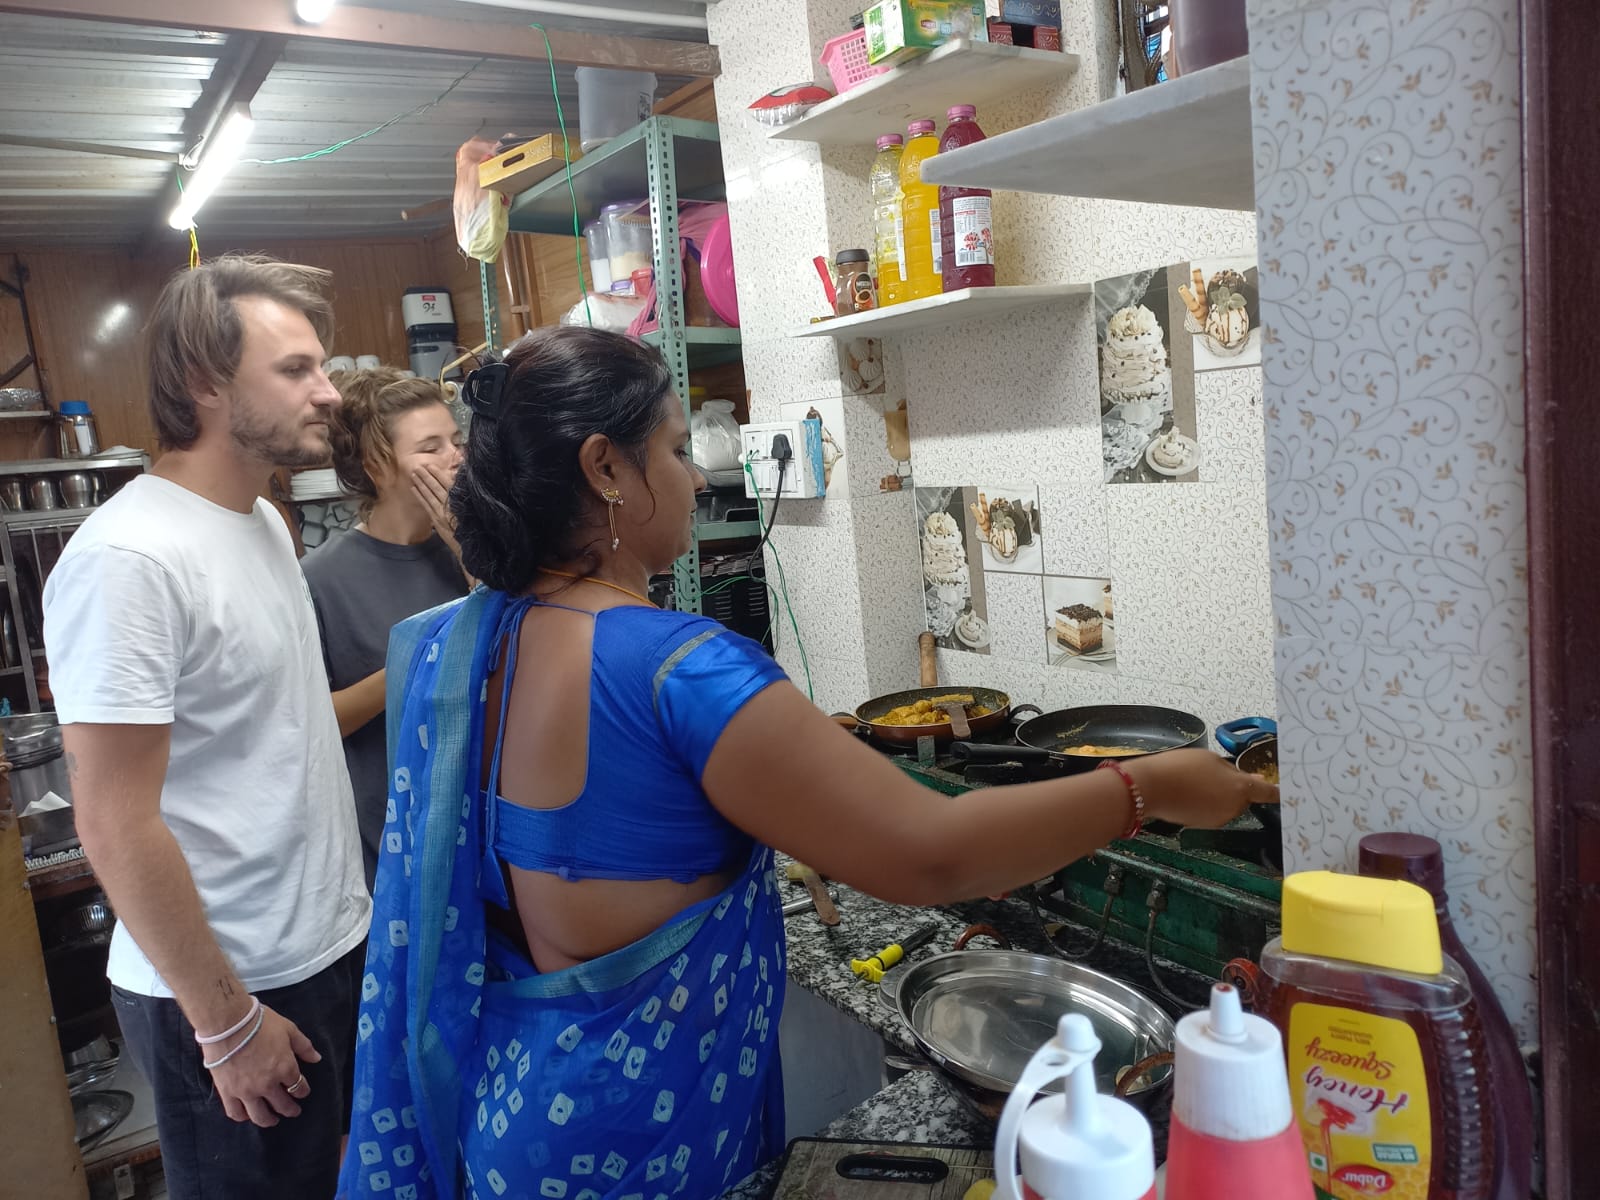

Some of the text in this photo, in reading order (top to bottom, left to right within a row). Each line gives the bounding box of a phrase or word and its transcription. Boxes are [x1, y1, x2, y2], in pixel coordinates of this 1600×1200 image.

[1305, 1037, 1394, 1080] Squeezy
[1306, 1066, 1407, 1113] Honey
[1342, 1172, 1386, 1188] Dabur
